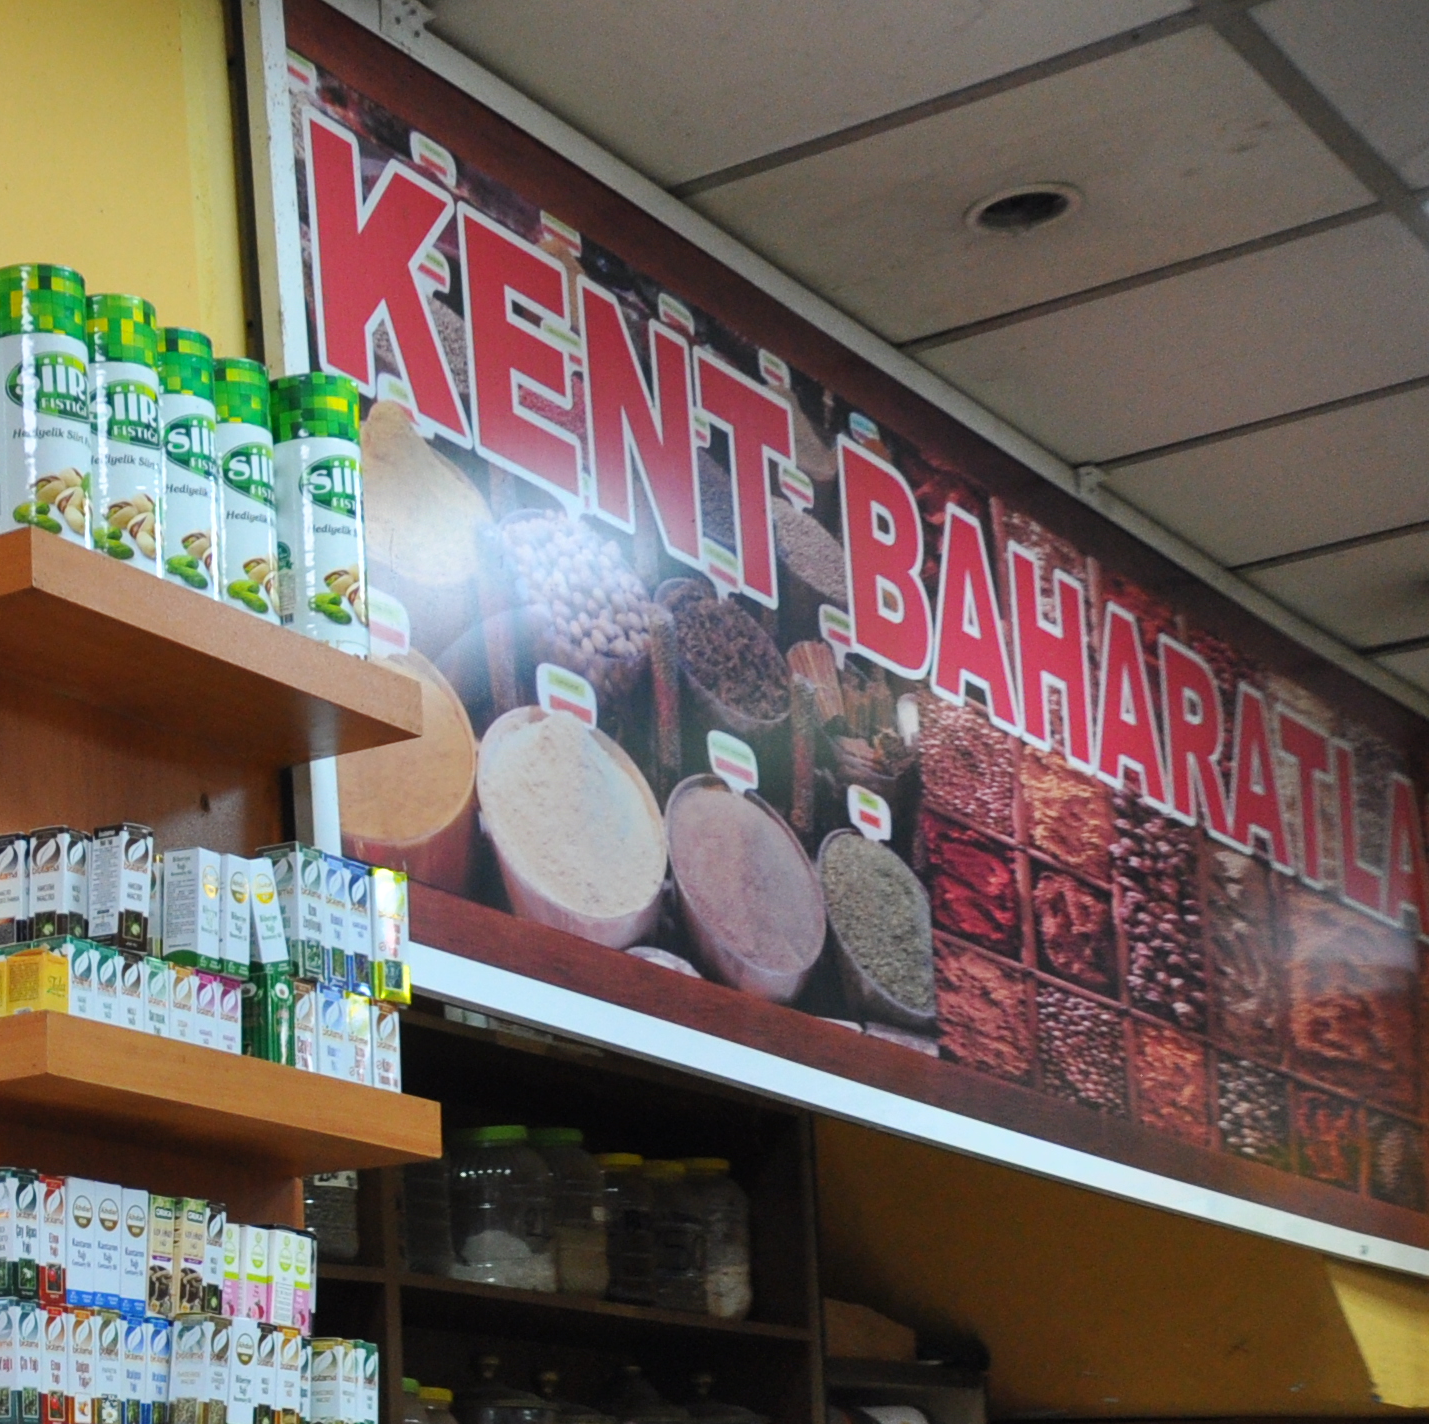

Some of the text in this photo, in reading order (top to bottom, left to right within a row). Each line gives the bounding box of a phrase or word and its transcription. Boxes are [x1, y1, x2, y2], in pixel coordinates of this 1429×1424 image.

[14, 357, 87, 399] SİİR
[303, 109, 795, 610] KENT
[91, 384, 160, 425] SİİR
